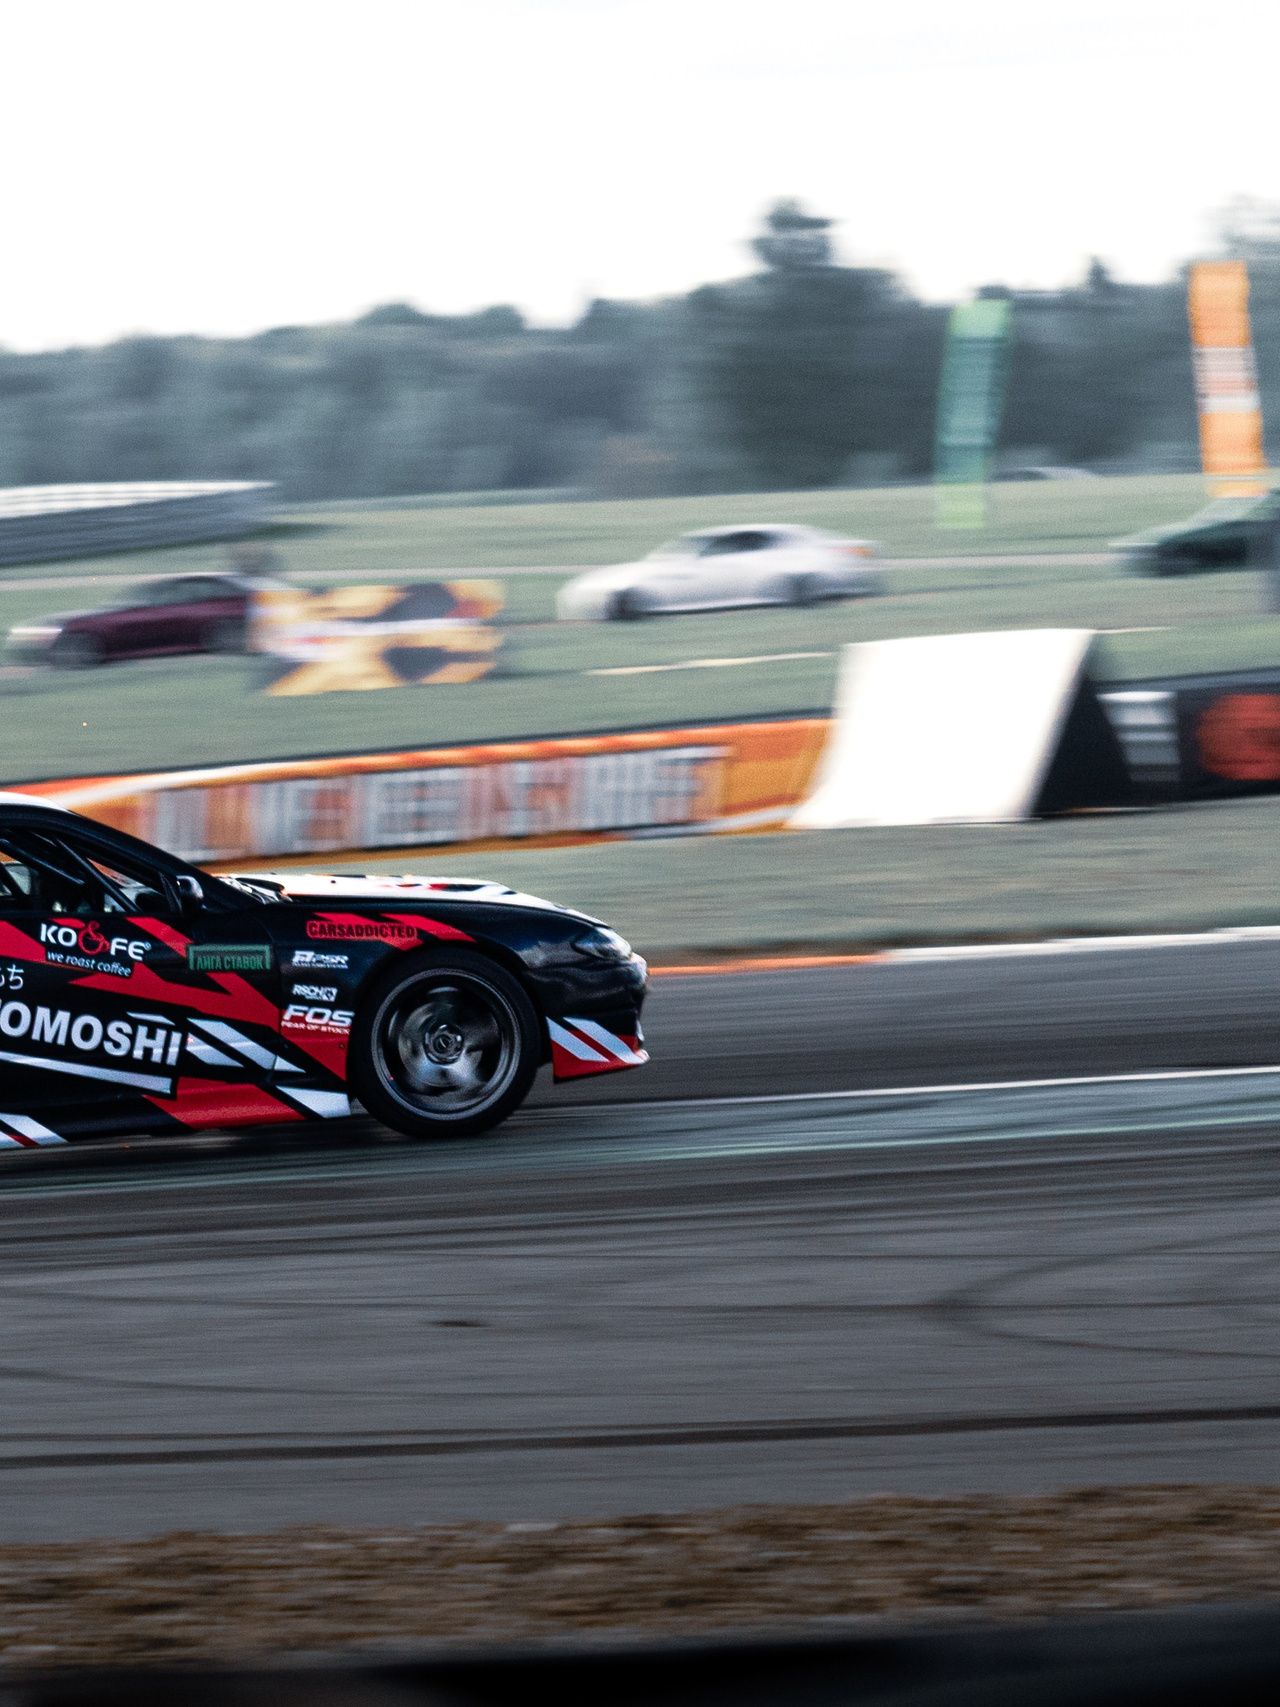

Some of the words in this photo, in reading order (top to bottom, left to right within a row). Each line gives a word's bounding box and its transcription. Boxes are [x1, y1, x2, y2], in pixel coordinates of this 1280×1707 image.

[308, 922, 416, 938] CARSADDICTED
[47, 951, 64, 962] we
[65, 954, 95, 970] roast
[97, 961, 131, 977] coffee
[223, 955, 264, 970] СТАВОК
[283, 1004, 355, 1027] FOS
